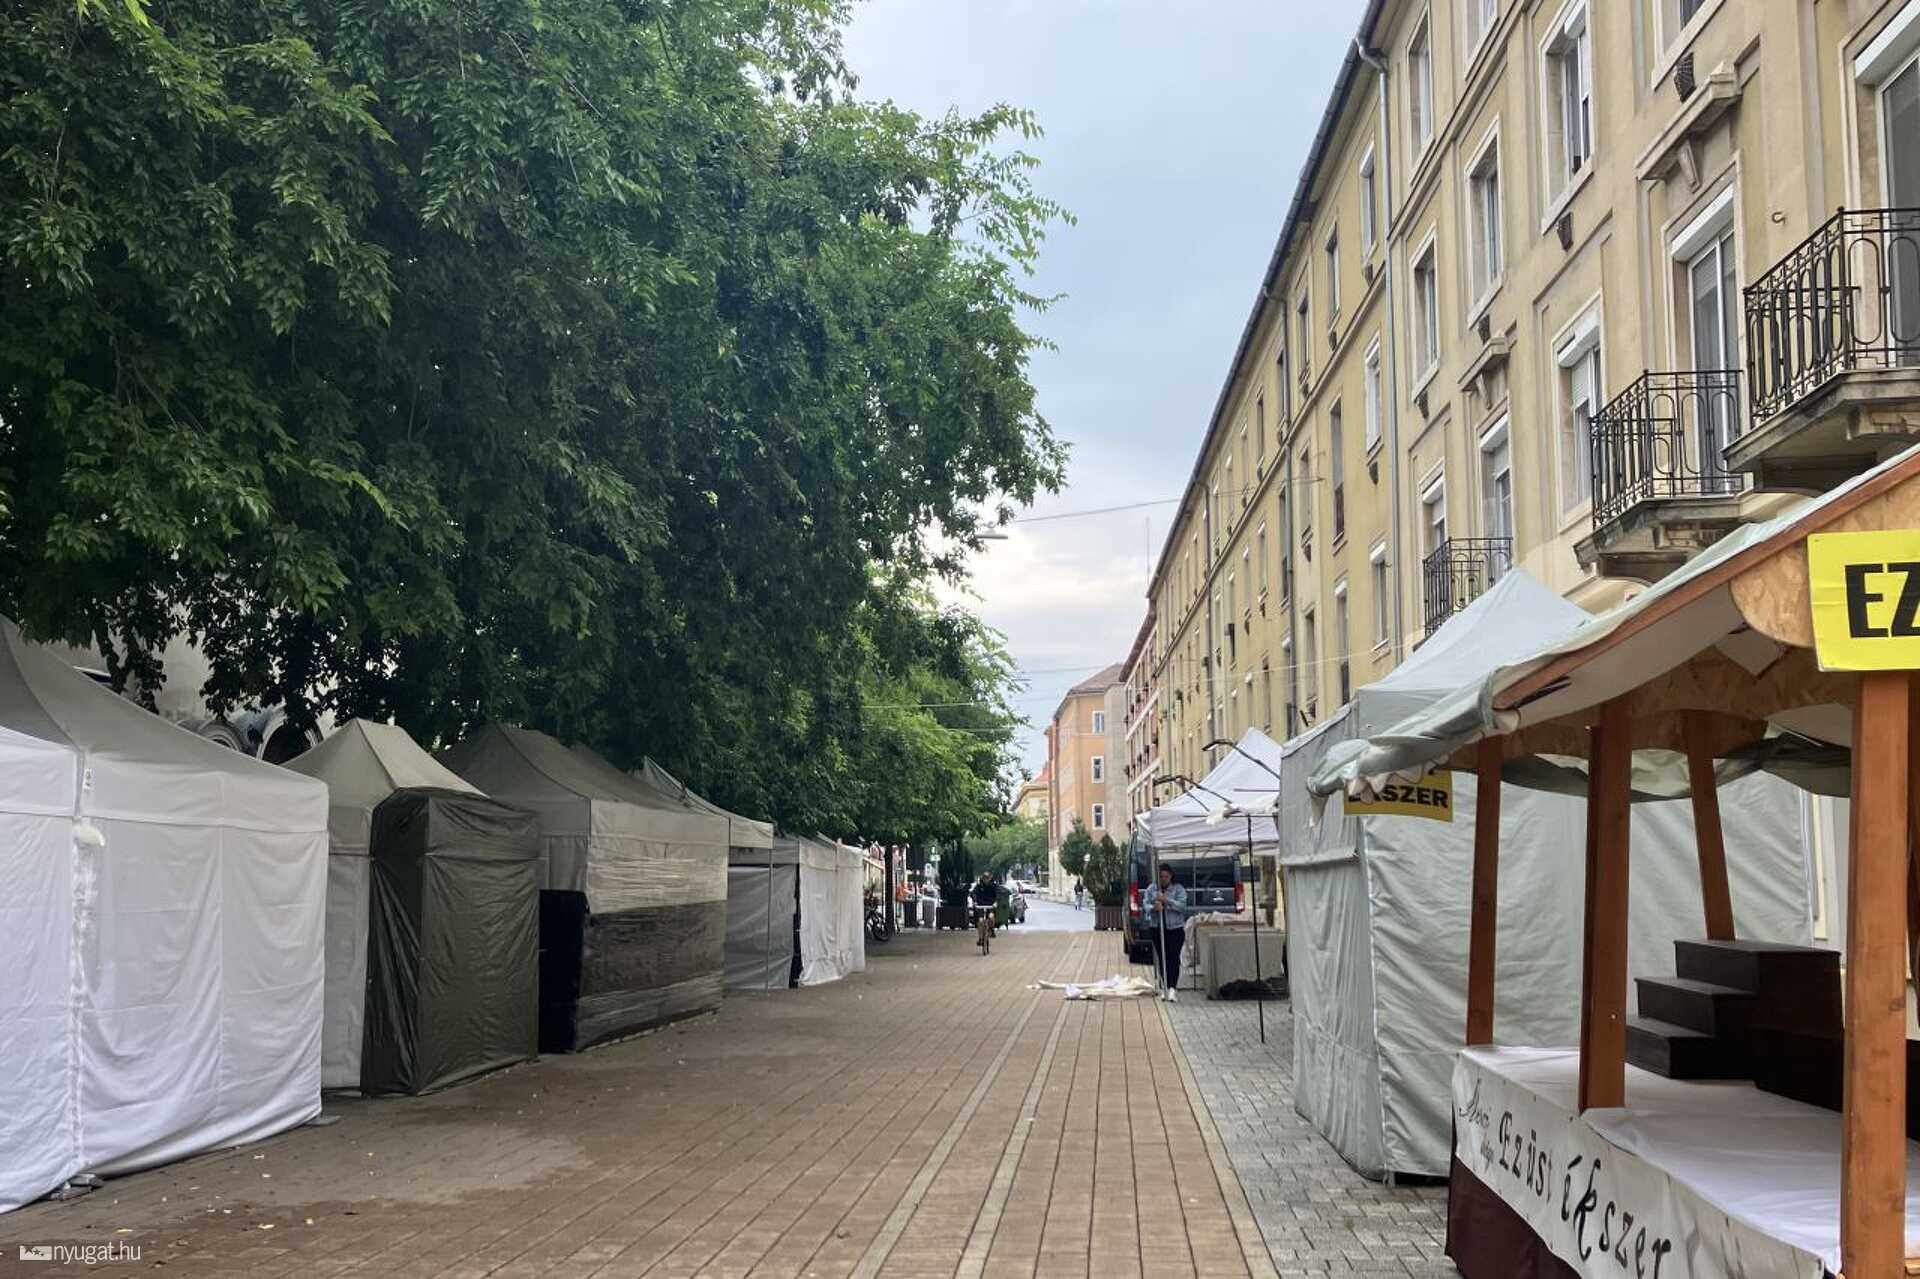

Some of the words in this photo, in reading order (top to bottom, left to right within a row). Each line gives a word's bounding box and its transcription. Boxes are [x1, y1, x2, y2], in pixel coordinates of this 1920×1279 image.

[1845, 562, 1920, 638] EZ
[1348, 784, 1448, 808] SZER
[1499, 1111, 1552, 1203] Ezüst
[1561, 1155, 1672, 1279] ékszer
